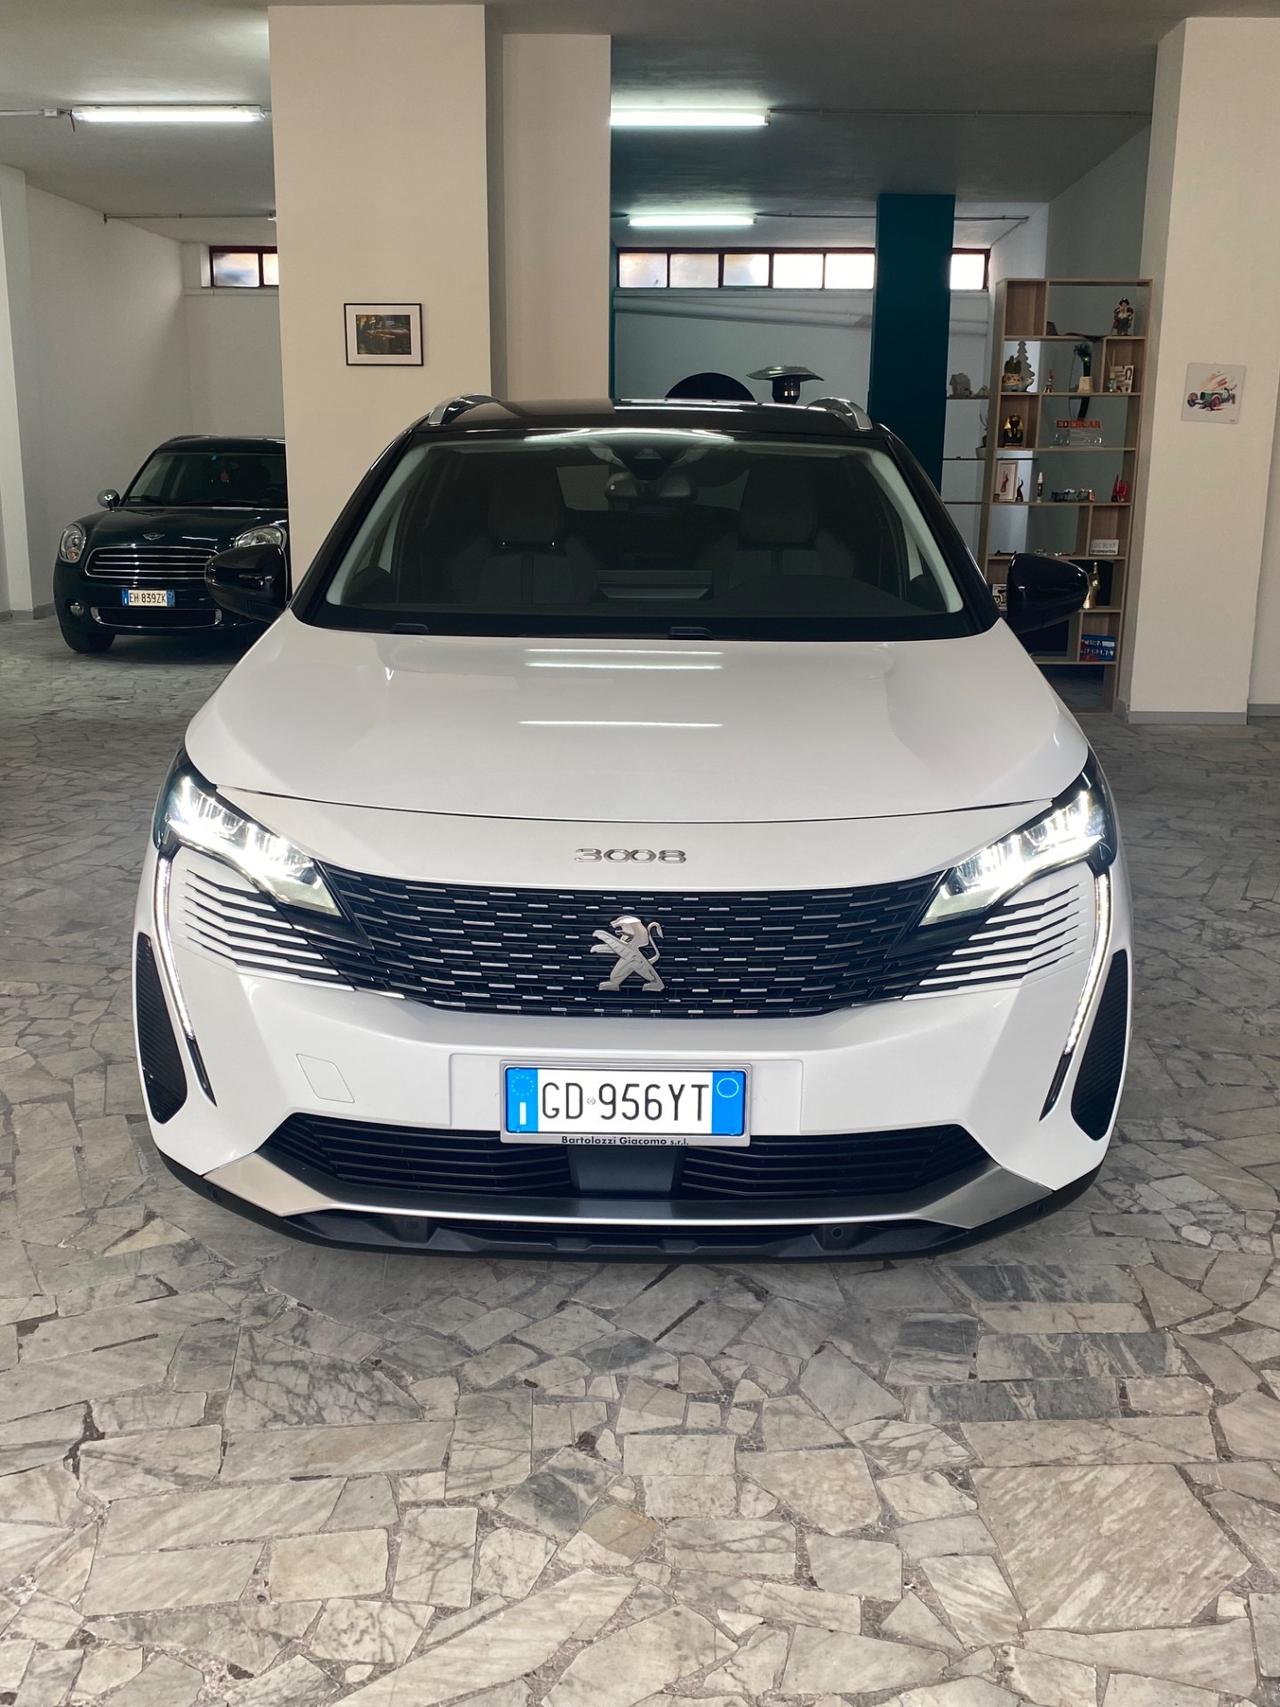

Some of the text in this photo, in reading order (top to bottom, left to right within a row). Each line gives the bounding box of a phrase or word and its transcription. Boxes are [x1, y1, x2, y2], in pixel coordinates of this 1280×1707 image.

[575, 848, 687, 864] 3008
[542, 1082, 710, 1122] GD 956YT
[561, 1135, 689, 1146] Bartolozzi Giacomo s.r.l.
